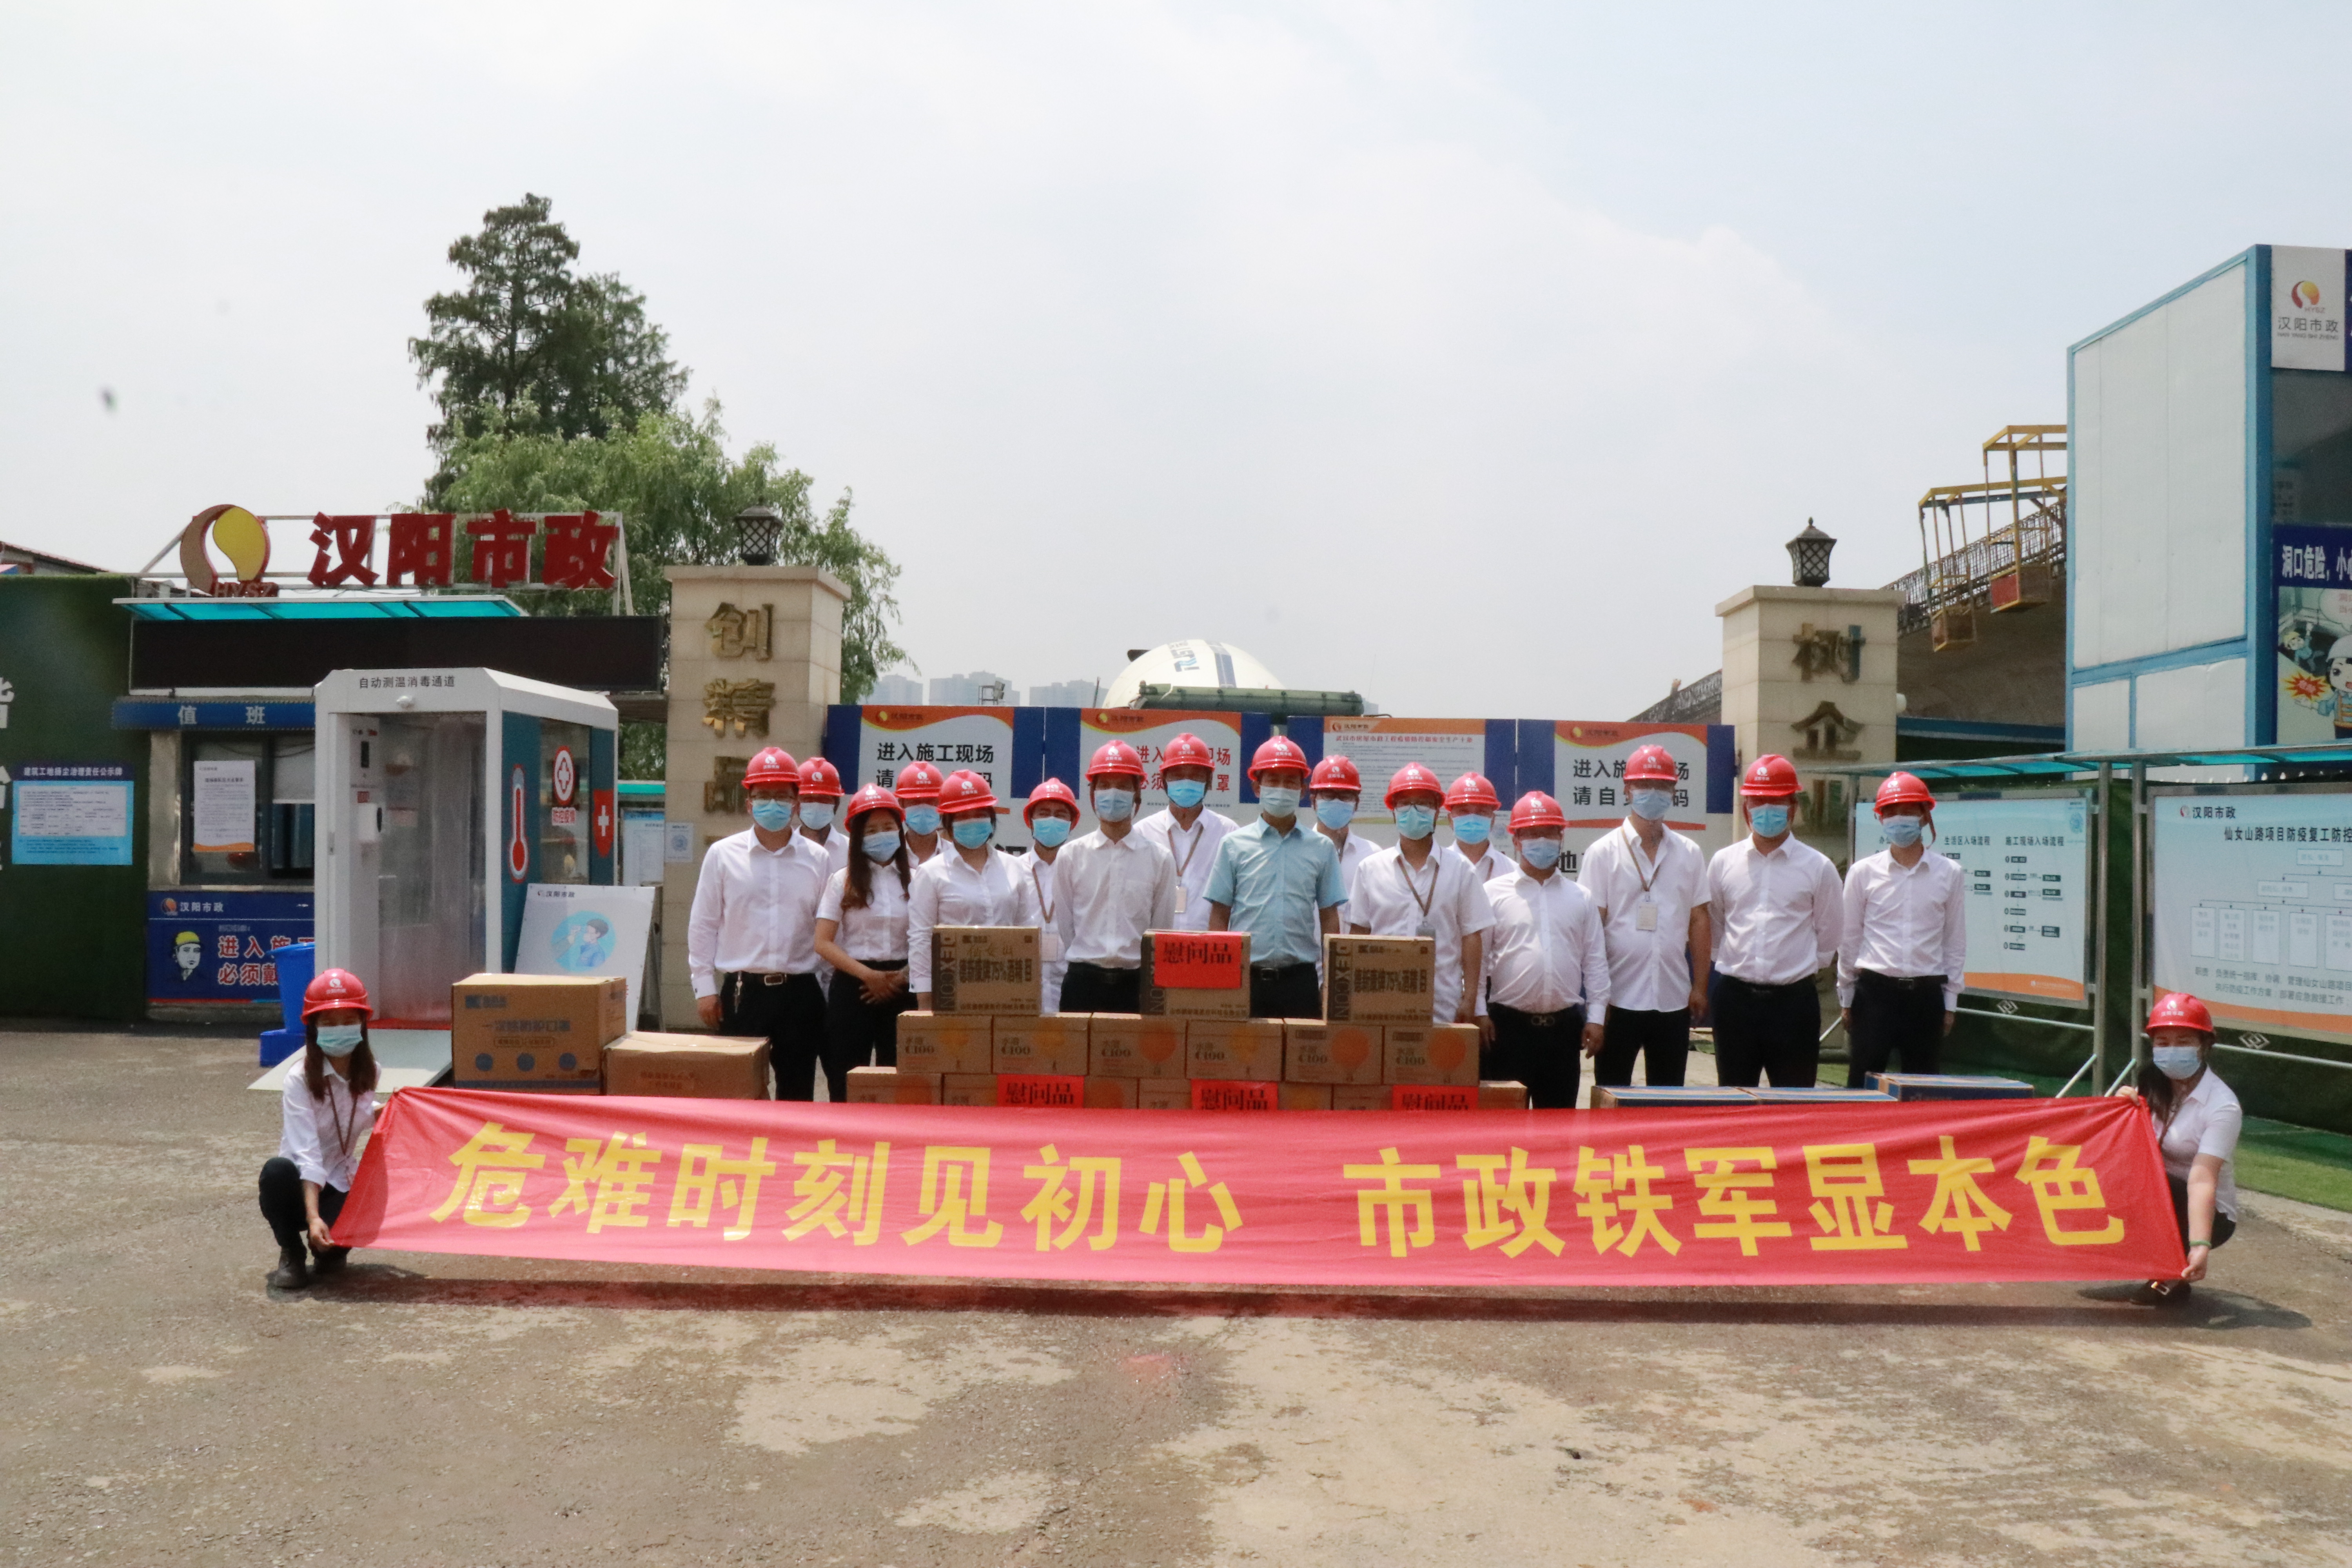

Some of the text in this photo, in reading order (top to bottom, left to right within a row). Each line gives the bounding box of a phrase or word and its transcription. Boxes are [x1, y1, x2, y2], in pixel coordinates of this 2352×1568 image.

[2278, 317, 2338, 332] 汉阳市政
[308, 508, 619, 590] 汉阳市政
[359, 675, 455, 689] 自动测温消毒通道
[178, 706, 266, 725] 值班
[877, 743, 993, 763] 进入施工现场
[1573, 759, 1689, 780] 进入施场
[1573, 786, 1688, 807] 请自码
[2192, 806, 2236, 819] 汉阳市政
[1944, 836, 2065, 847] 生活区入场流程 施工现场入场流程
[180, 902, 224, 913] 汉阳市政
[1163, 942, 1232, 964] 慰问品
[1005, 1081, 1074, 1105] 慰问品
[1201, 1088, 1268, 1110] 慰问品
[428, 1120, 2125, 1258] 危难时刻见初心 市政铁军显本色
